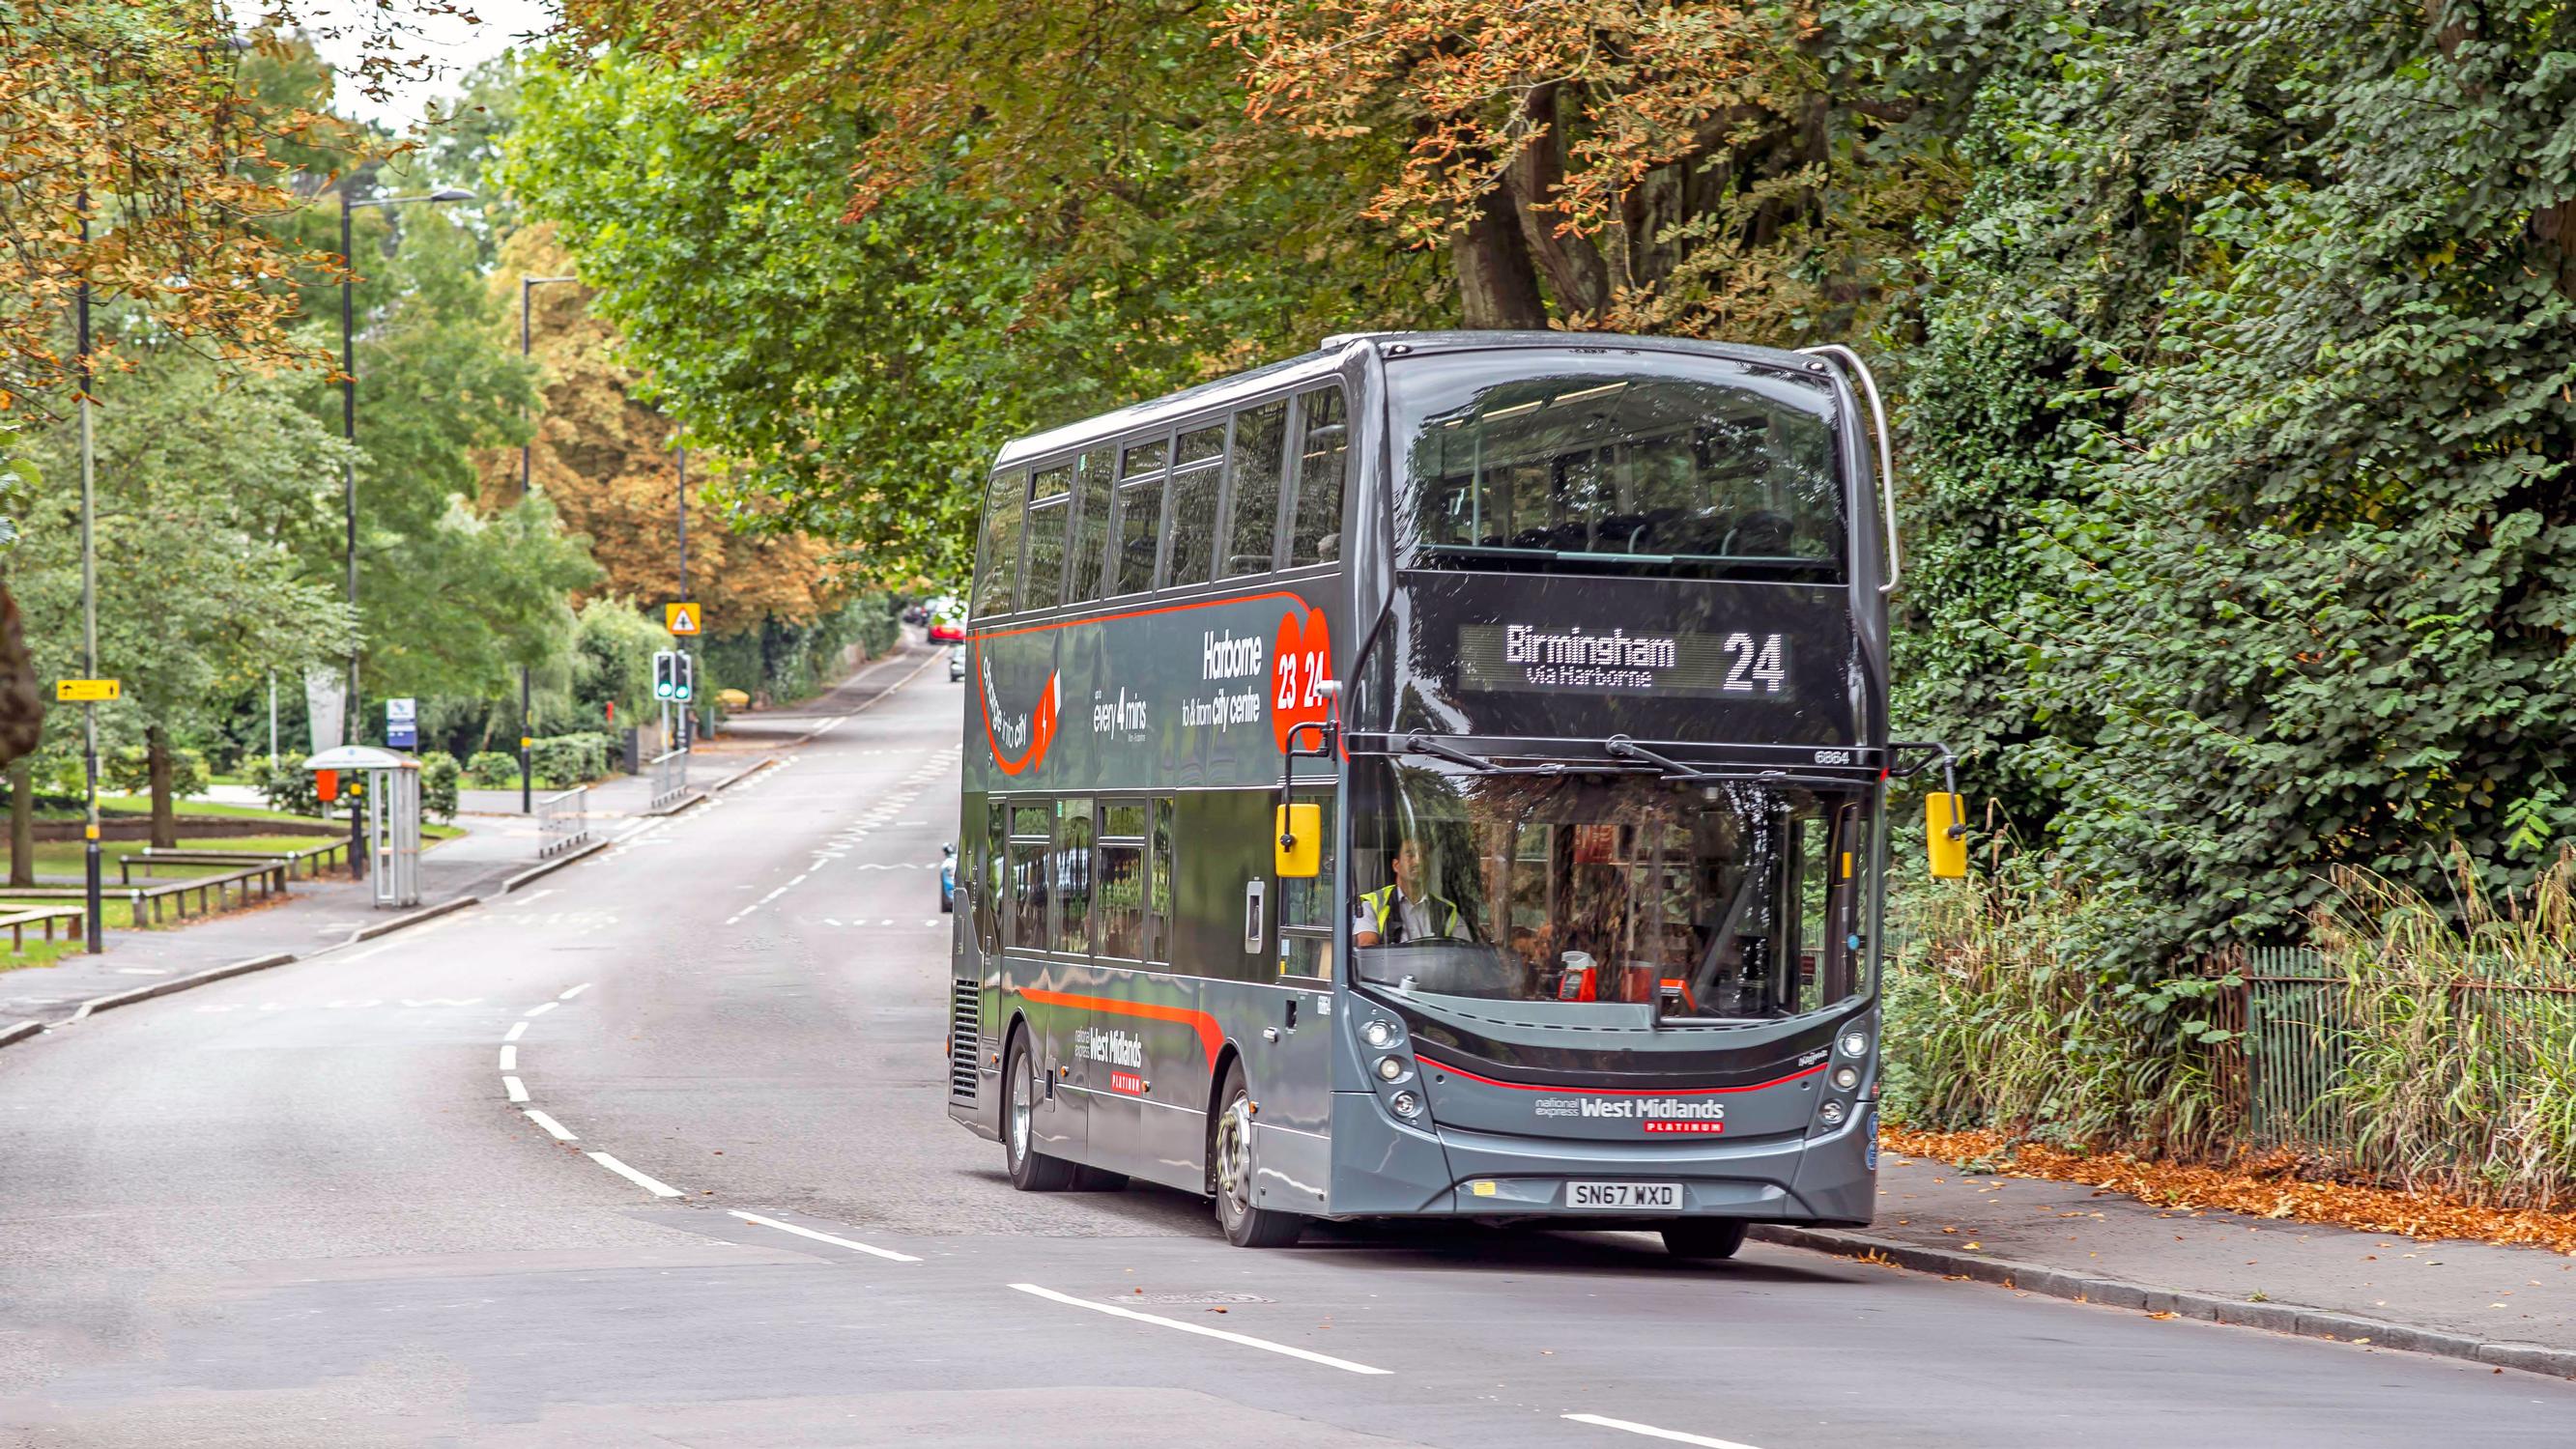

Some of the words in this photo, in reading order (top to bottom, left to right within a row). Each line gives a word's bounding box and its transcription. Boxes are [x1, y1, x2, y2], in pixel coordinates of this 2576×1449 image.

[1203, 628, 1263, 680] Harborne
[1506, 624, 1675, 668] Birmingham
[1723, 632, 1785, 693] 24
[1276, 652, 1297, 710] 23
[1303, 650, 1325, 708] 24
[1526, 665, 1556, 684] via
[1560, 665, 1652, 688] Harborne
[1093, 702, 1117, 741] every
[1117, 686, 1125, 730] 4
[1126, 692, 1147, 730] mins
[1182, 698, 1189, 727] to
[1189, 697, 1196, 726] &
[1196, 697, 1212, 726] from
[1212, 687, 1230, 732] city
[1229, 685, 1260, 724] centre
[1015, 712, 1027, 749] city
[1090, 1027, 1108, 1063] West
[1109, 1030, 1142, 1068] Midlands
[1112, 1073, 1140, 1093] PLATINUM
[1534, 1097, 1580, 1108] national
[1534, 1107, 1580, 1119] express
[1580, 1097, 1633, 1118] West
[1636, 1097, 1725, 1119] Midlands
[1646, 1122, 1722, 1132] PLATINUM
[1575, 1185, 1628, 1205] SN67
[1635, 1186, 1674, 1205] WXD
